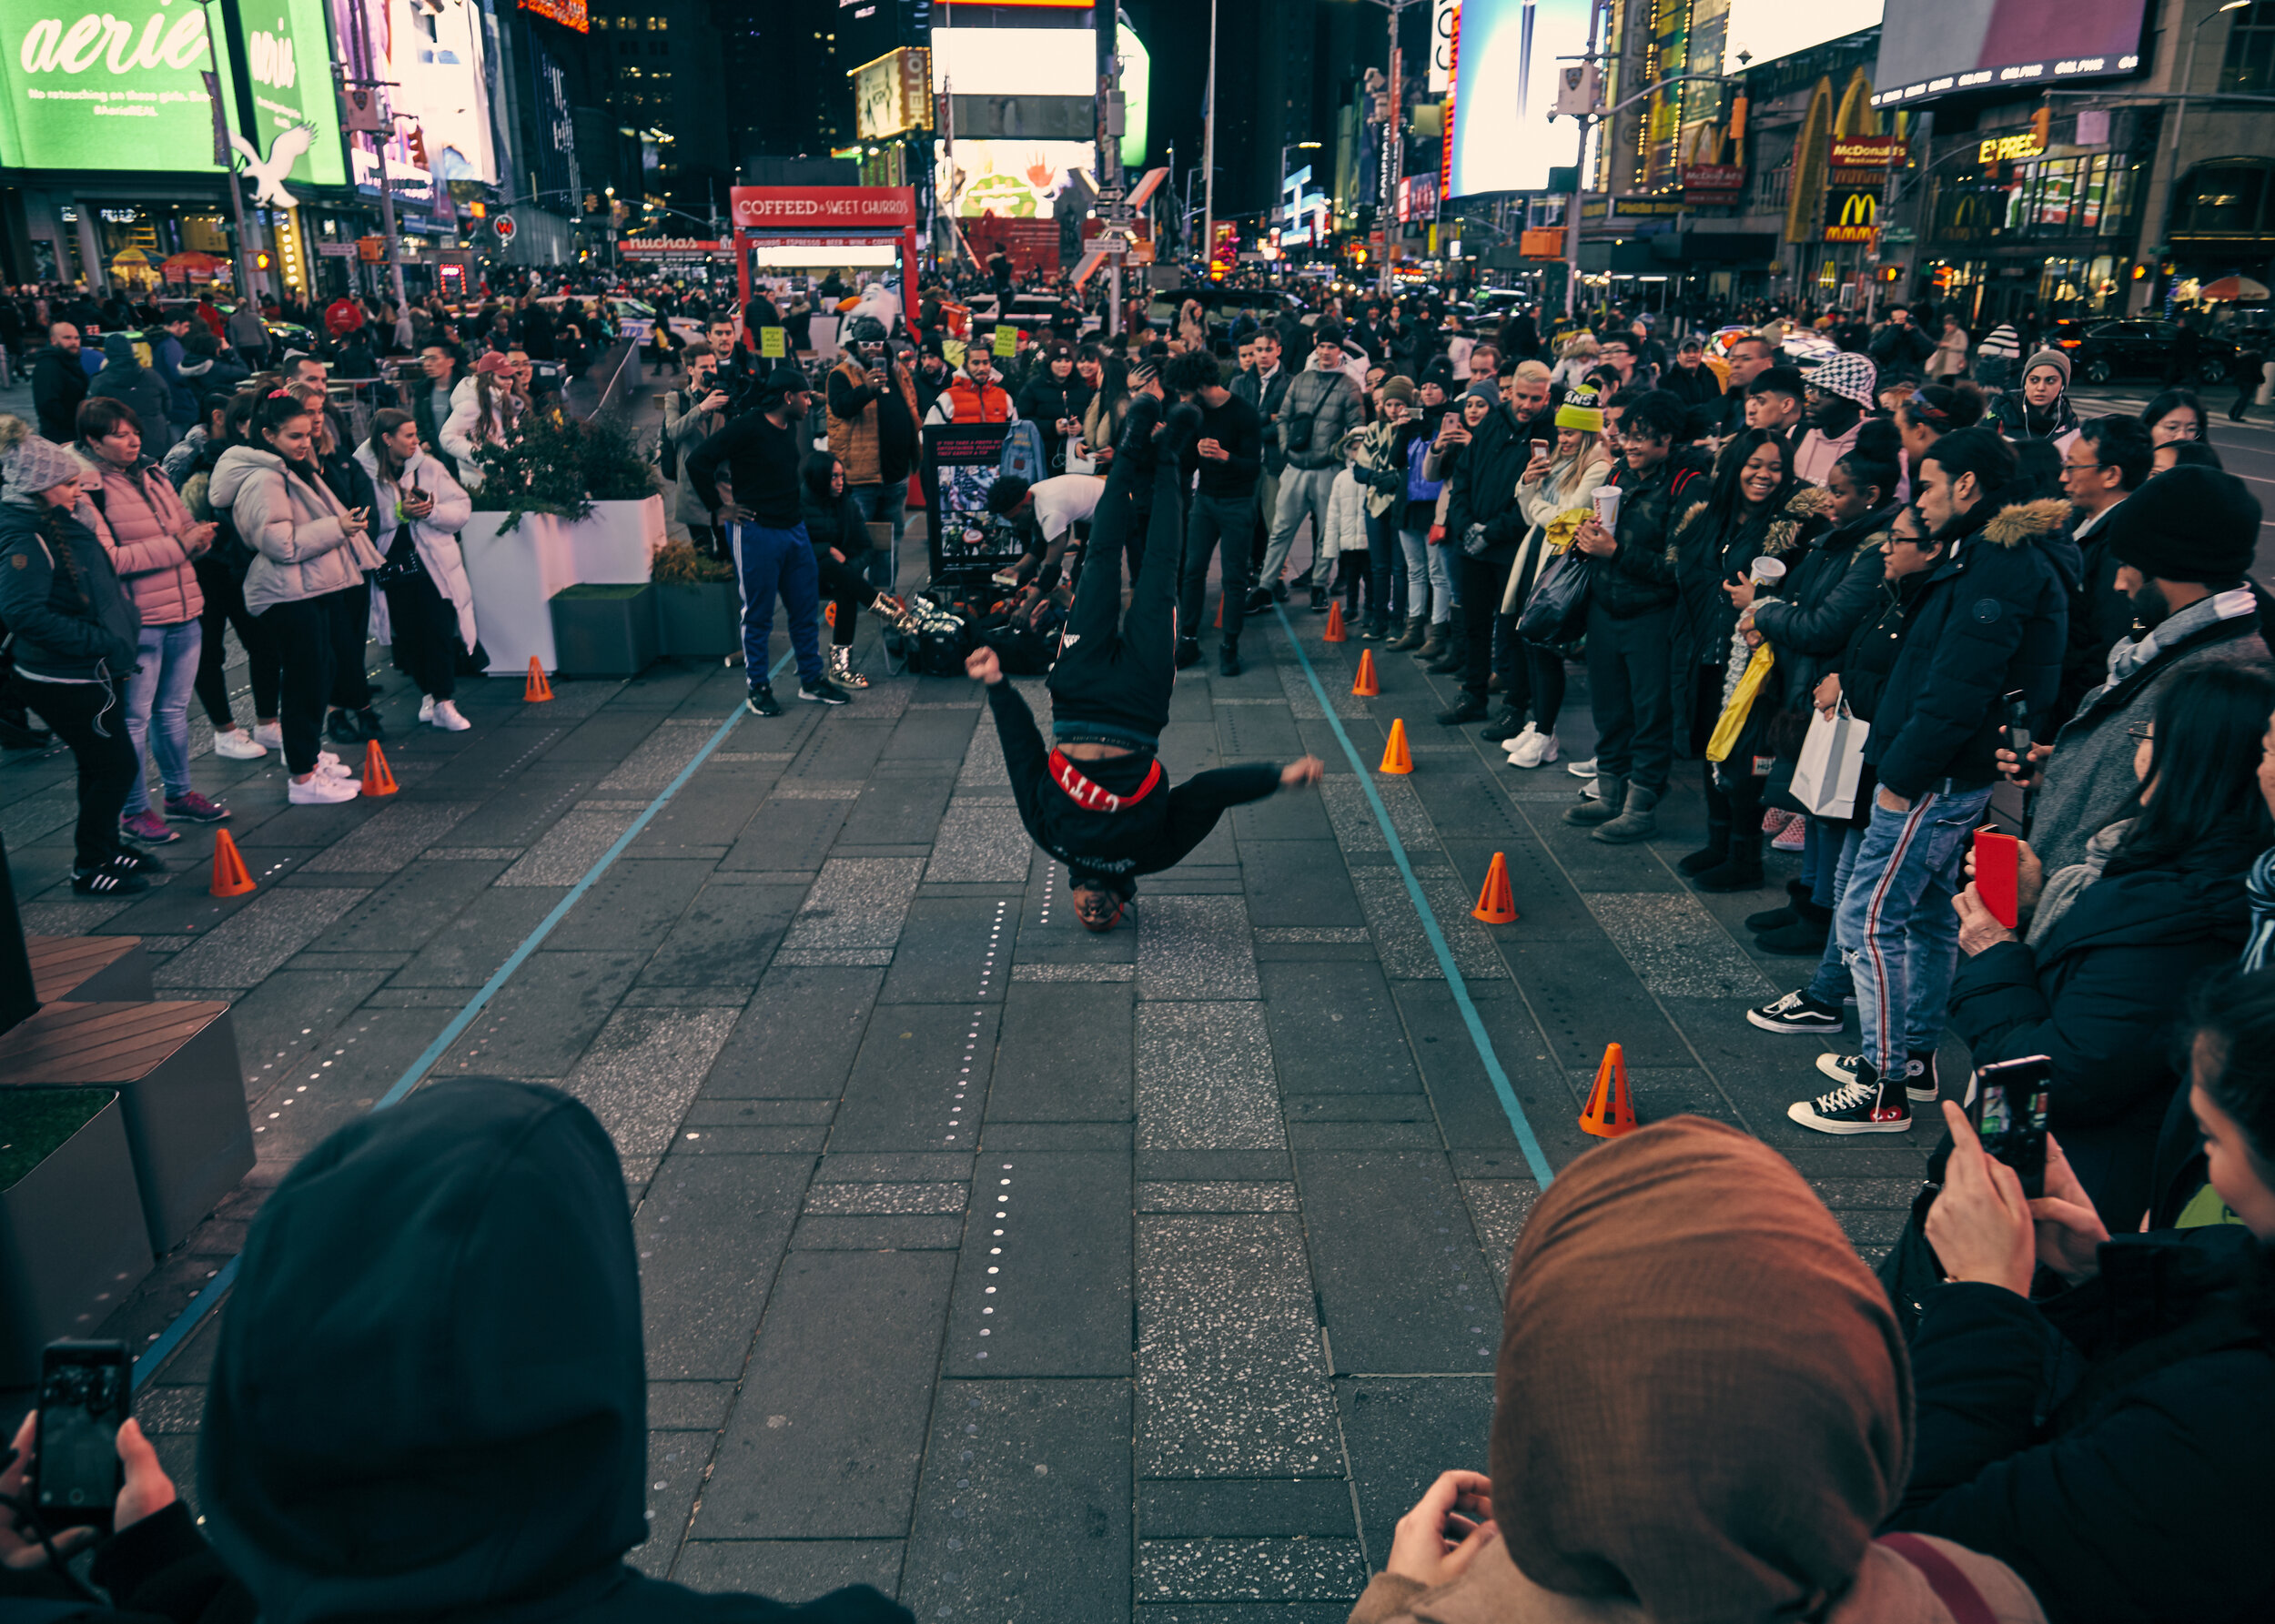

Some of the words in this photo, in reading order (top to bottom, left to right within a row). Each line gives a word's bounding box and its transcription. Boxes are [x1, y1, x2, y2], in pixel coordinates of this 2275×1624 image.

[20, 0, 209, 75] aerie
[28, 88, 46, 99] No
[47, 88, 108, 103] retouching
[109, 92, 126, 100] on
[907, 52, 926, 125] HELLO!
[1977, 133, 2044, 164] EPRES
[739, 199, 818, 215] COFFEED
[825, 199, 859, 215] SWEET
[862, 199, 909, 215] CHURROS
[629, 233, 698, 249] nuchas
[622, 327, 643, 337] YPD
[1563, 389, 1596, 406] ANS
[1061, 764, 1119, 812] CITY
